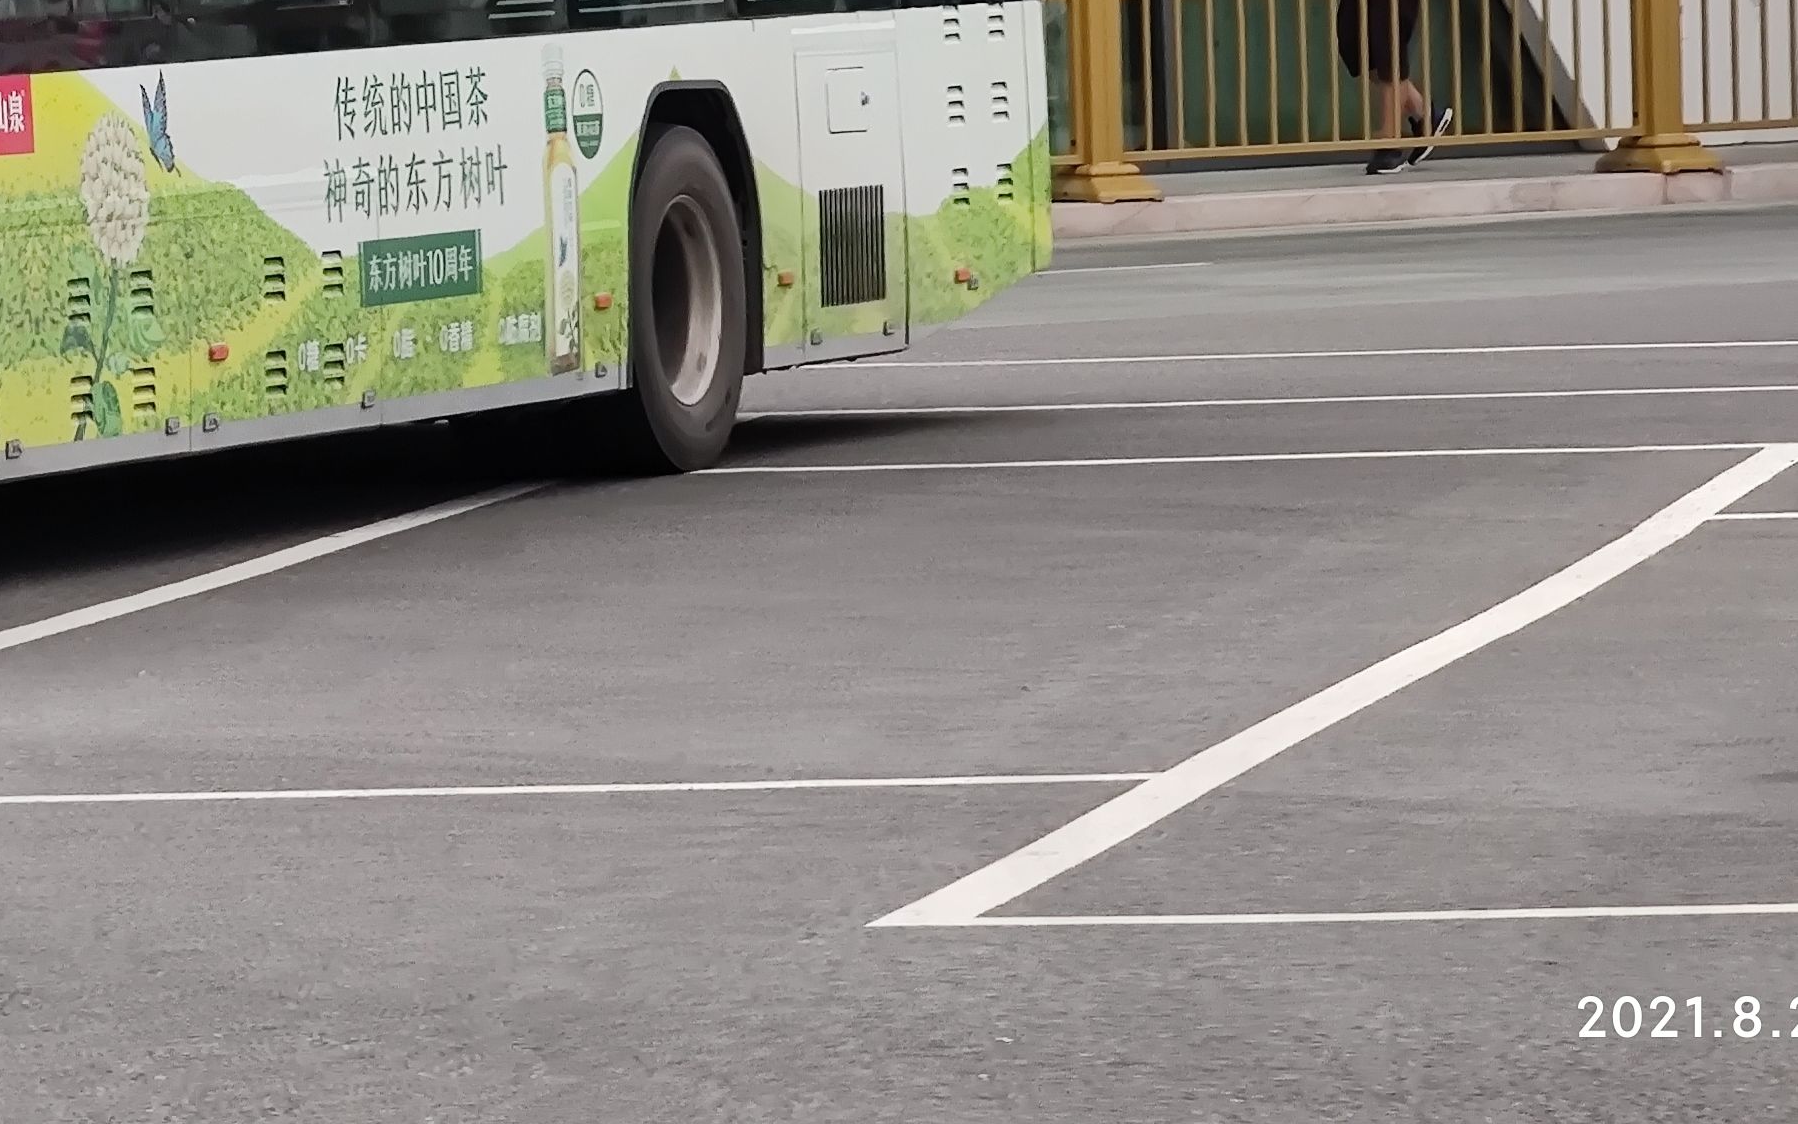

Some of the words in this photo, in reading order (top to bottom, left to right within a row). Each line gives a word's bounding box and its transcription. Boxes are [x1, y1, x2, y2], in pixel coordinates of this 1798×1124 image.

[333, 66, 489, 141] 传统的中国茶
[322, 144, 508, 224] 神奇的东方树叶
[368, 244, 475, 293] 东方树叶10周年
